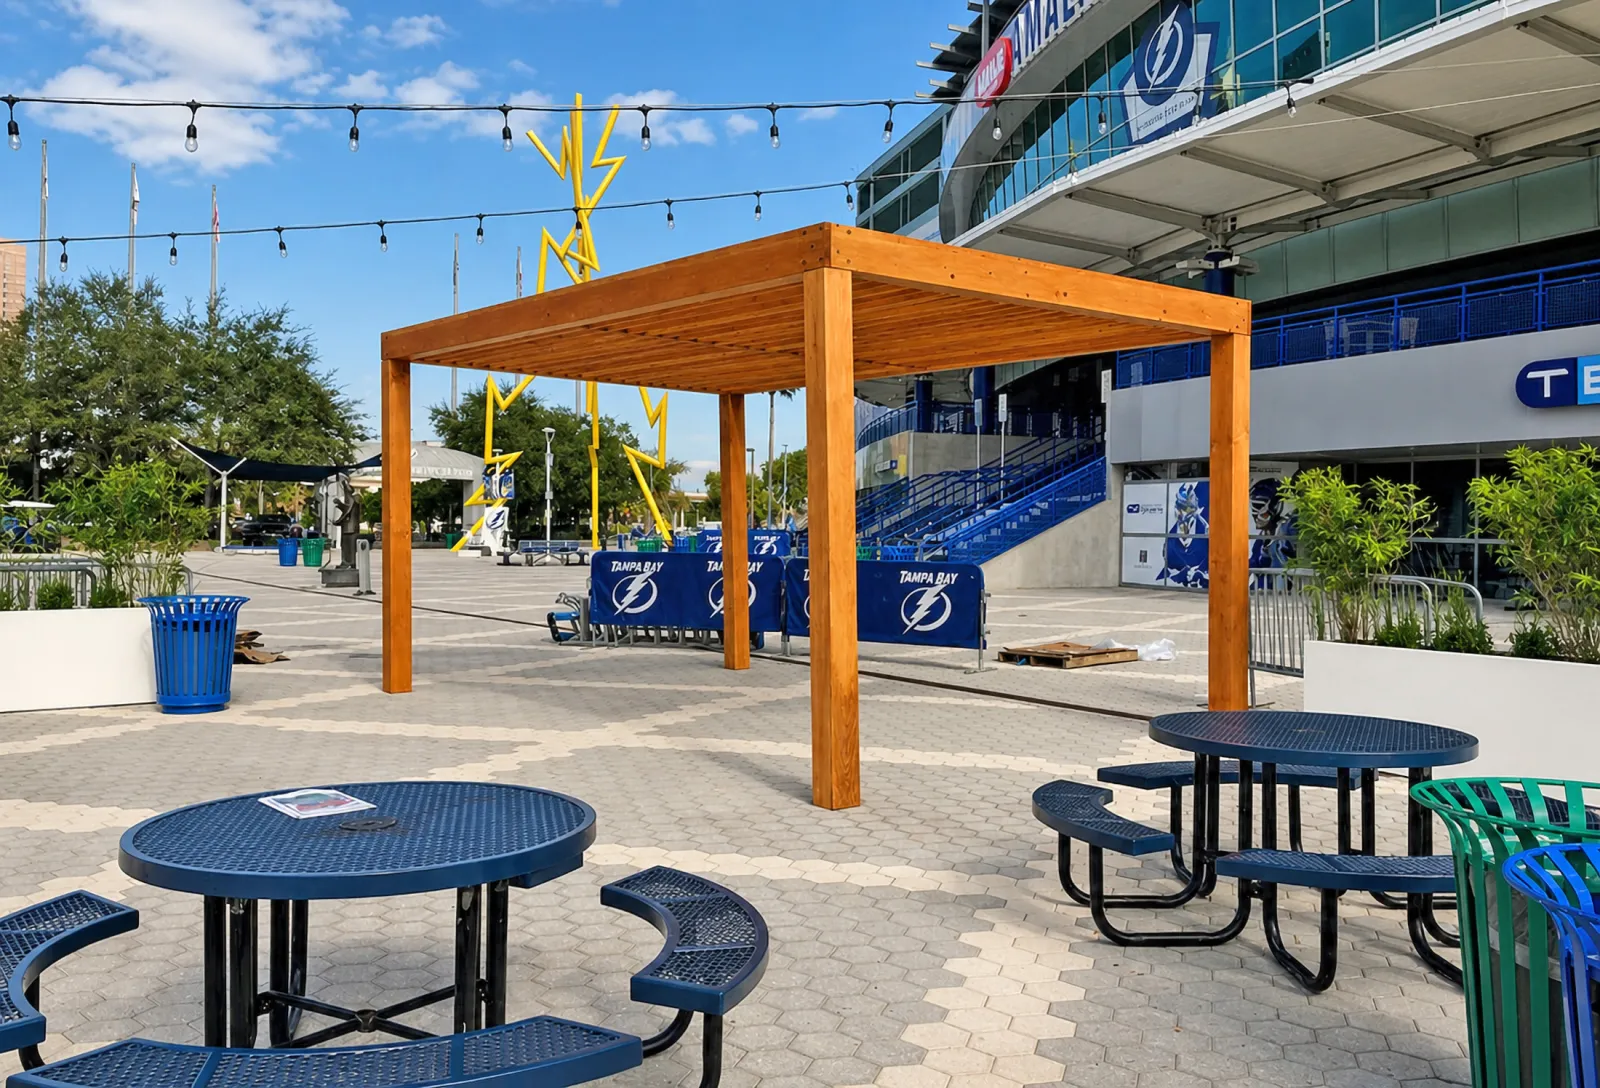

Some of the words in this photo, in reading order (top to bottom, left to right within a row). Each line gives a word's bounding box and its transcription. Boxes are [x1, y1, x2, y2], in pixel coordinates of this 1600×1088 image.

[611, 560, 642, 572] TAMPA
[643, 561, 664, 573] BAY
[899, 570, 933, 584] TAMPA
[934, 572, 959, 585] BAY
